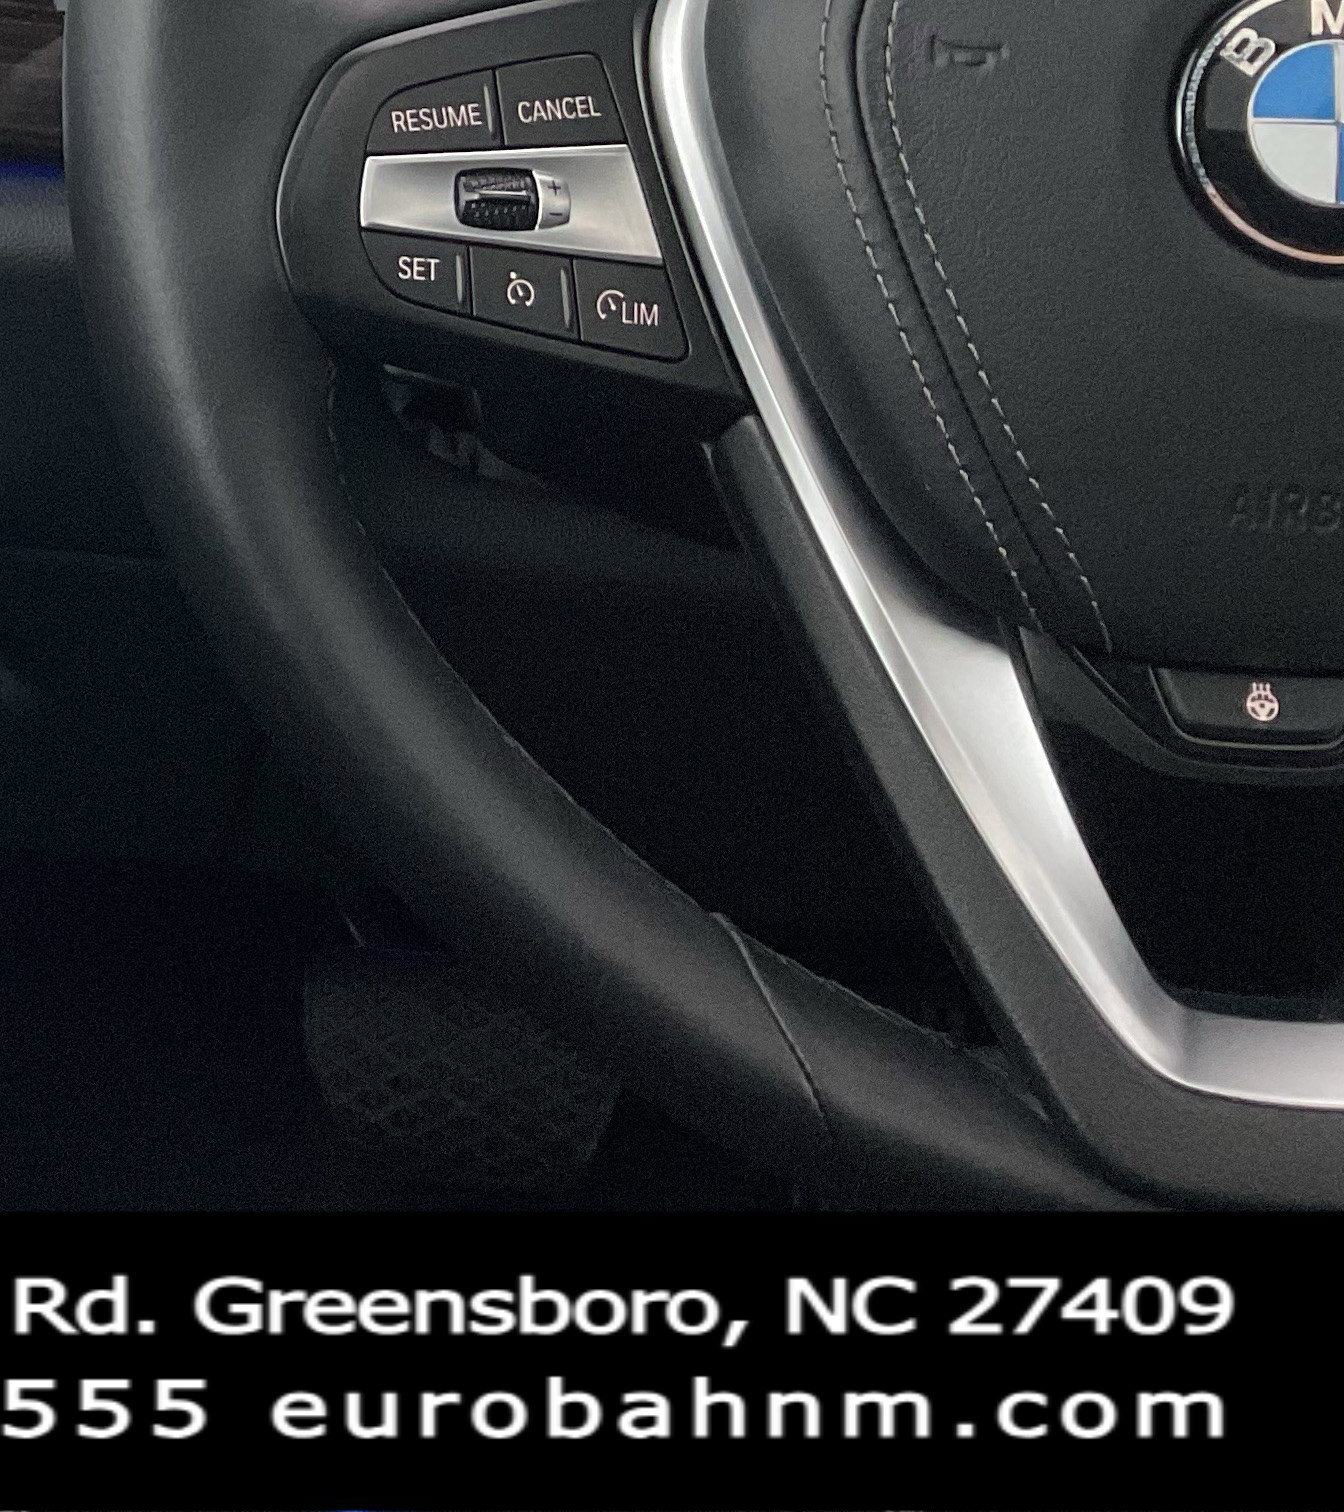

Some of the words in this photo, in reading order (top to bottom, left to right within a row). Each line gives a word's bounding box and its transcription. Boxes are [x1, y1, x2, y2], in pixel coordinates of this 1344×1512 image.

[391, 103, 483, 133] RESUME
[517, 95, 602, 124] CANCEL
[397, 256, 440, 281] SET
[621, 301, 660, 327] LIM
